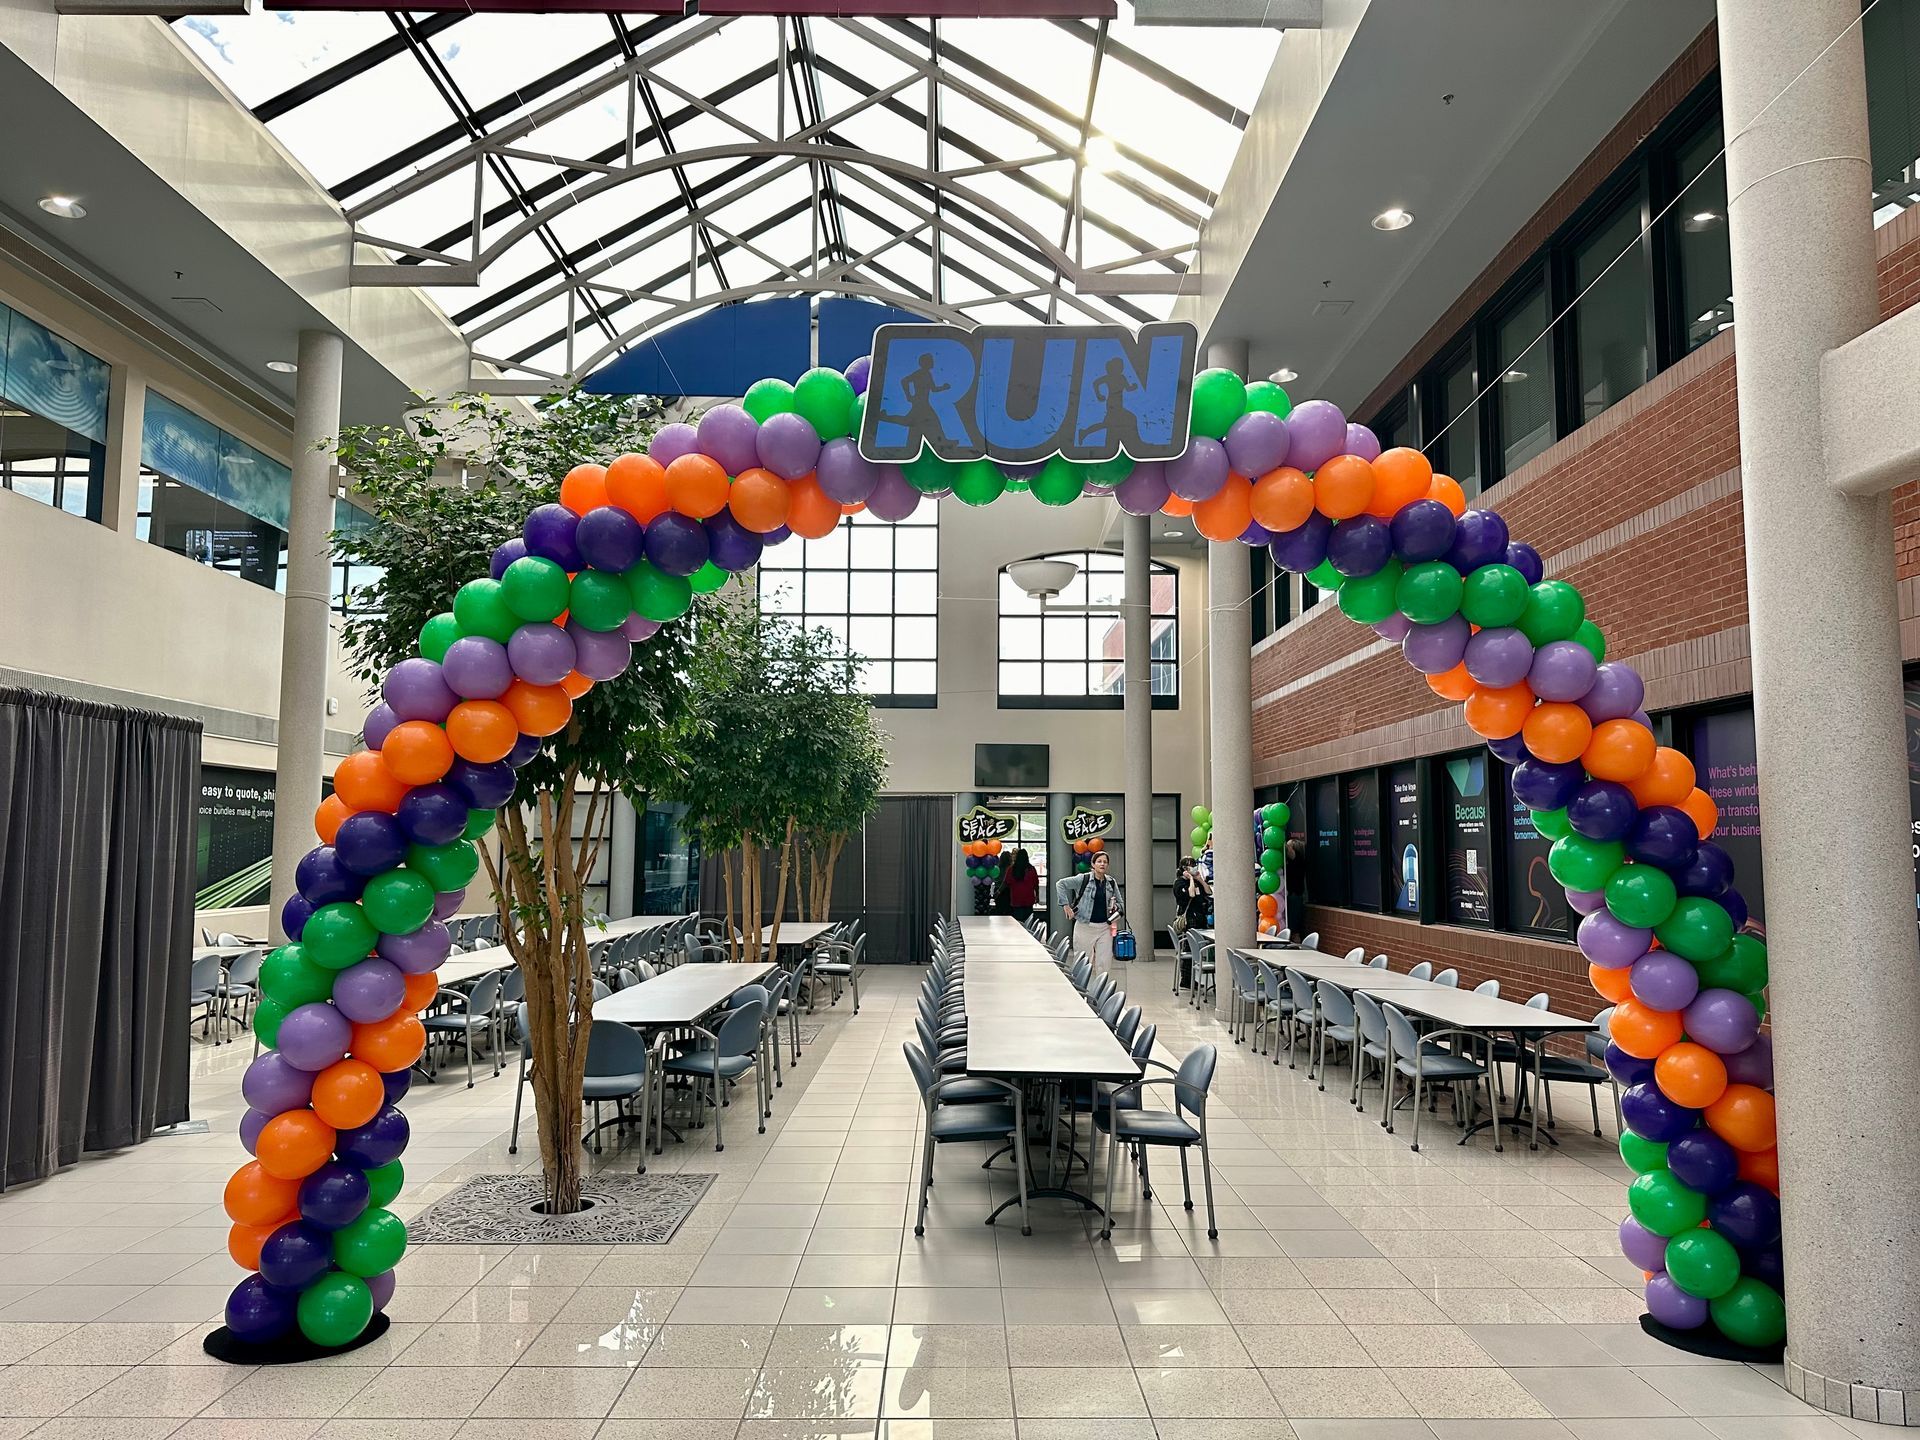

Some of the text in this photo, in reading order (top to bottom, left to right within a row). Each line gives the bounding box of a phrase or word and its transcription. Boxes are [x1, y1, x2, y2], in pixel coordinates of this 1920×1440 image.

[874, 336, 1184, 449] RUN
[1708, 765, 1737, 779] What's
[202, 786, 222, 799] easy
[225, 785, 233, 797] to
[236, 788, 261, 801] quote,
[1709, 786, 1732, 798] these
[199, 806, 212, 815] oice
[213, 806, 235, 815] bundles
[236, 808, 251, 816] make
[962, 814, 985, 836] SET
[970, 820, 1007, 840] PACE
[1066, 813, 1086, 834] SET
[1075, 815, 1107, 837] PACE
[1514, 831, 1540, 840] tomorrow.
